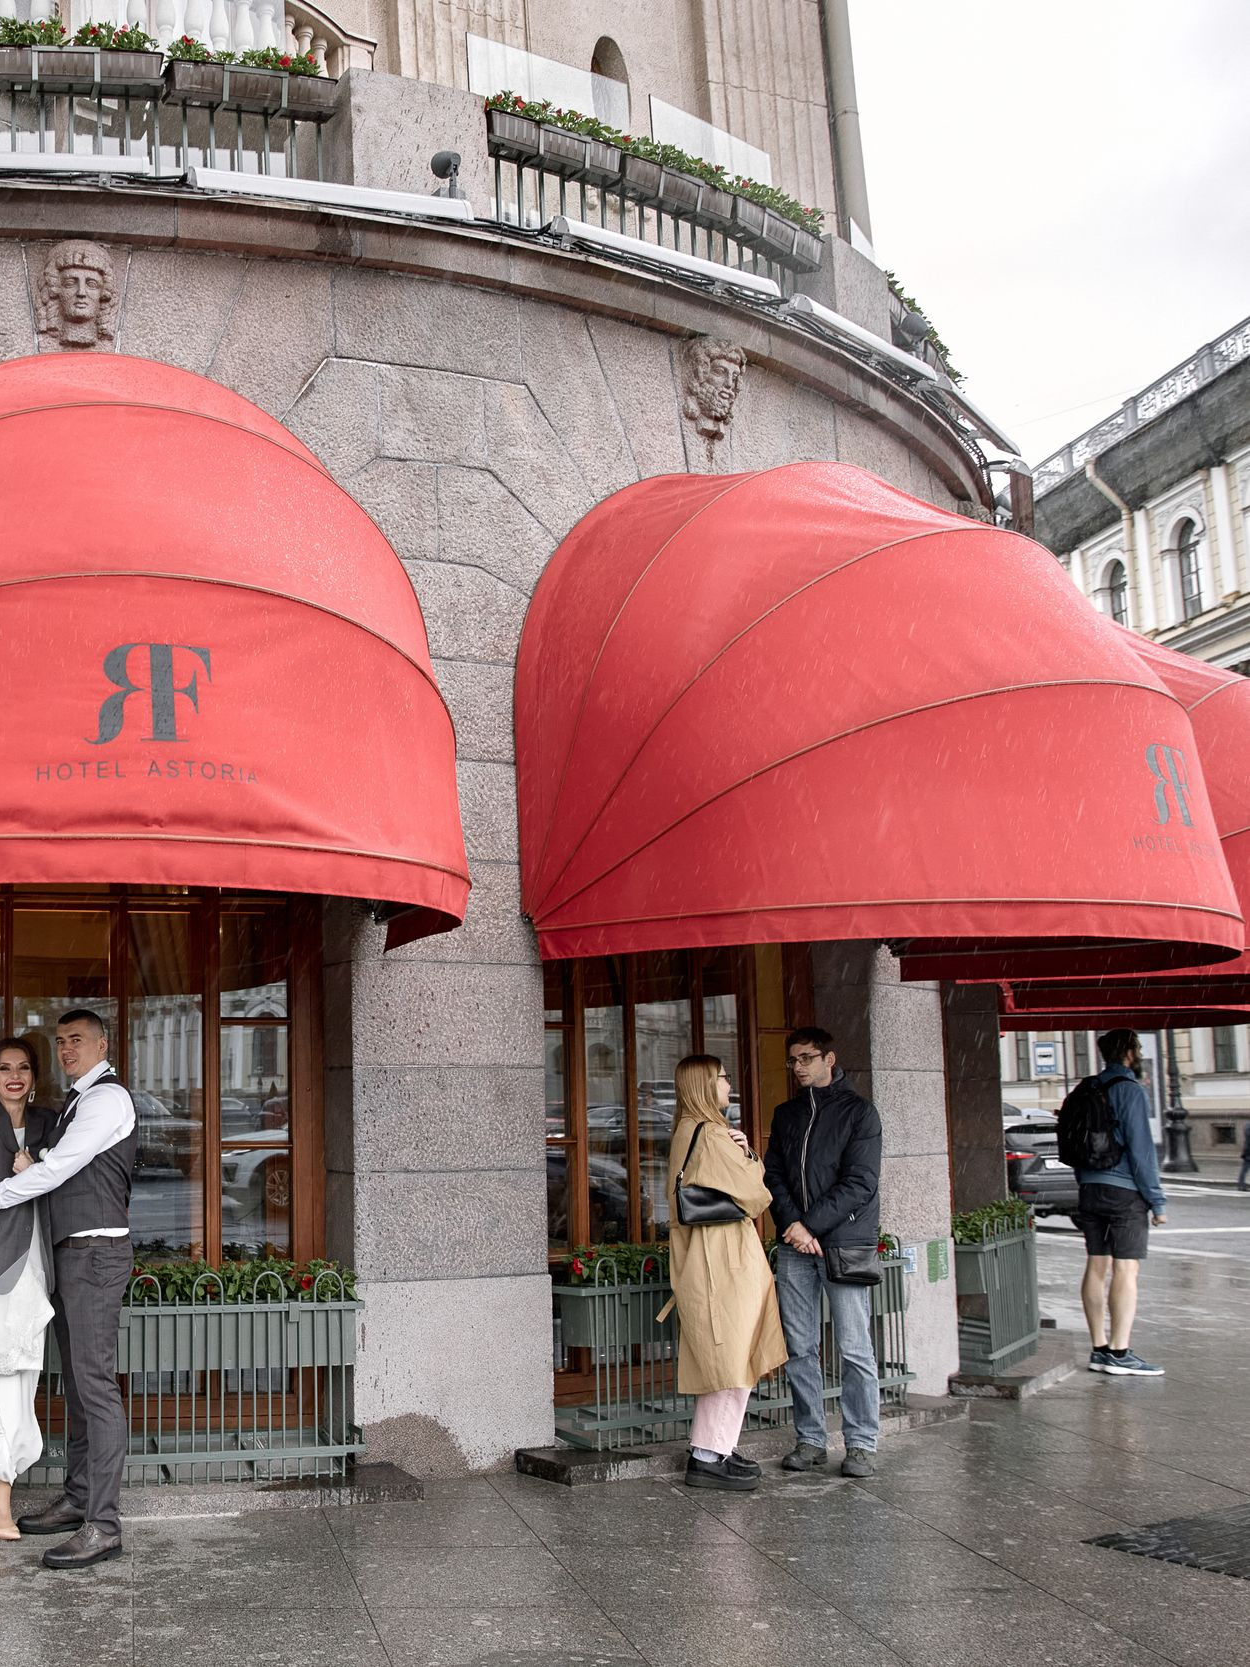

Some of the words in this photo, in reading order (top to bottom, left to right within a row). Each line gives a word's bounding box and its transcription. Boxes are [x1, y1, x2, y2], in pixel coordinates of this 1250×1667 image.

[36, 760, 126, 782] HOTEL
[147, 760, 259, 784] ASTORIA
[1132, 835, 1183, 853] HOTEL
